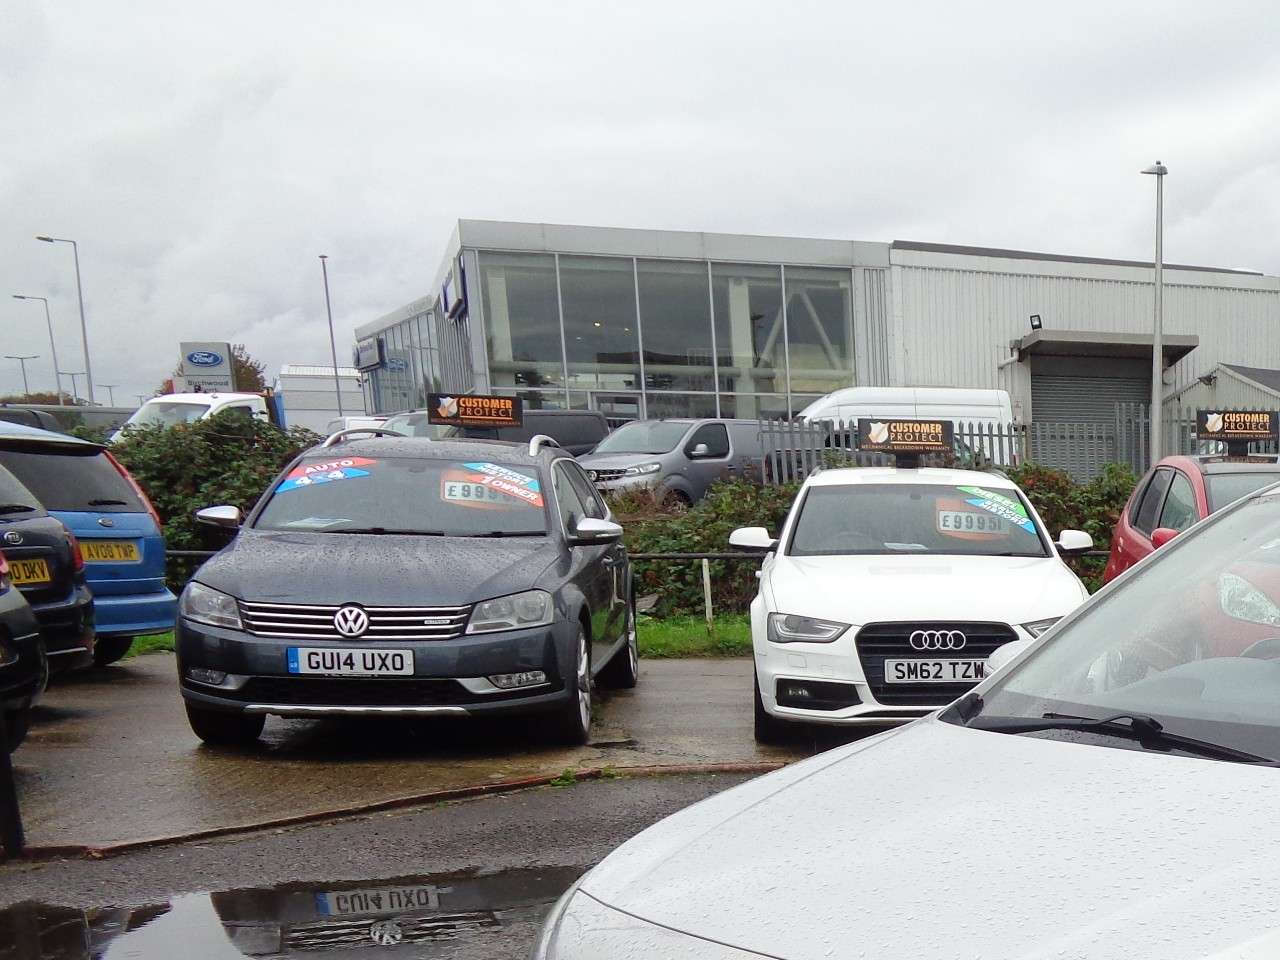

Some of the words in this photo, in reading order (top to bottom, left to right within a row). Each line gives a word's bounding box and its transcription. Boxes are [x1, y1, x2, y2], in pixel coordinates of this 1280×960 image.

[460, 397, 513, 409] CUSTOMER
[460, 407, 513, 417] PROTECT
[1224, 413, 1270, 423] CUSTOMER
[890, 422, 943, 434] CUSTOMER
[1224, 422, 1270, 431] PROTECT
[890, 432, 943, 442] PROTECT
[304, 459, 354, 474] AUTO
[491, 480, 538, 501] OWNER
[23, 560, 46, 579] DKV
[307, 651, 355, 671] GU14
[362, 652, 404, 672] UXO
[894, 662, 943, 680] SM62
[948, 661, 985, 679] TZW
